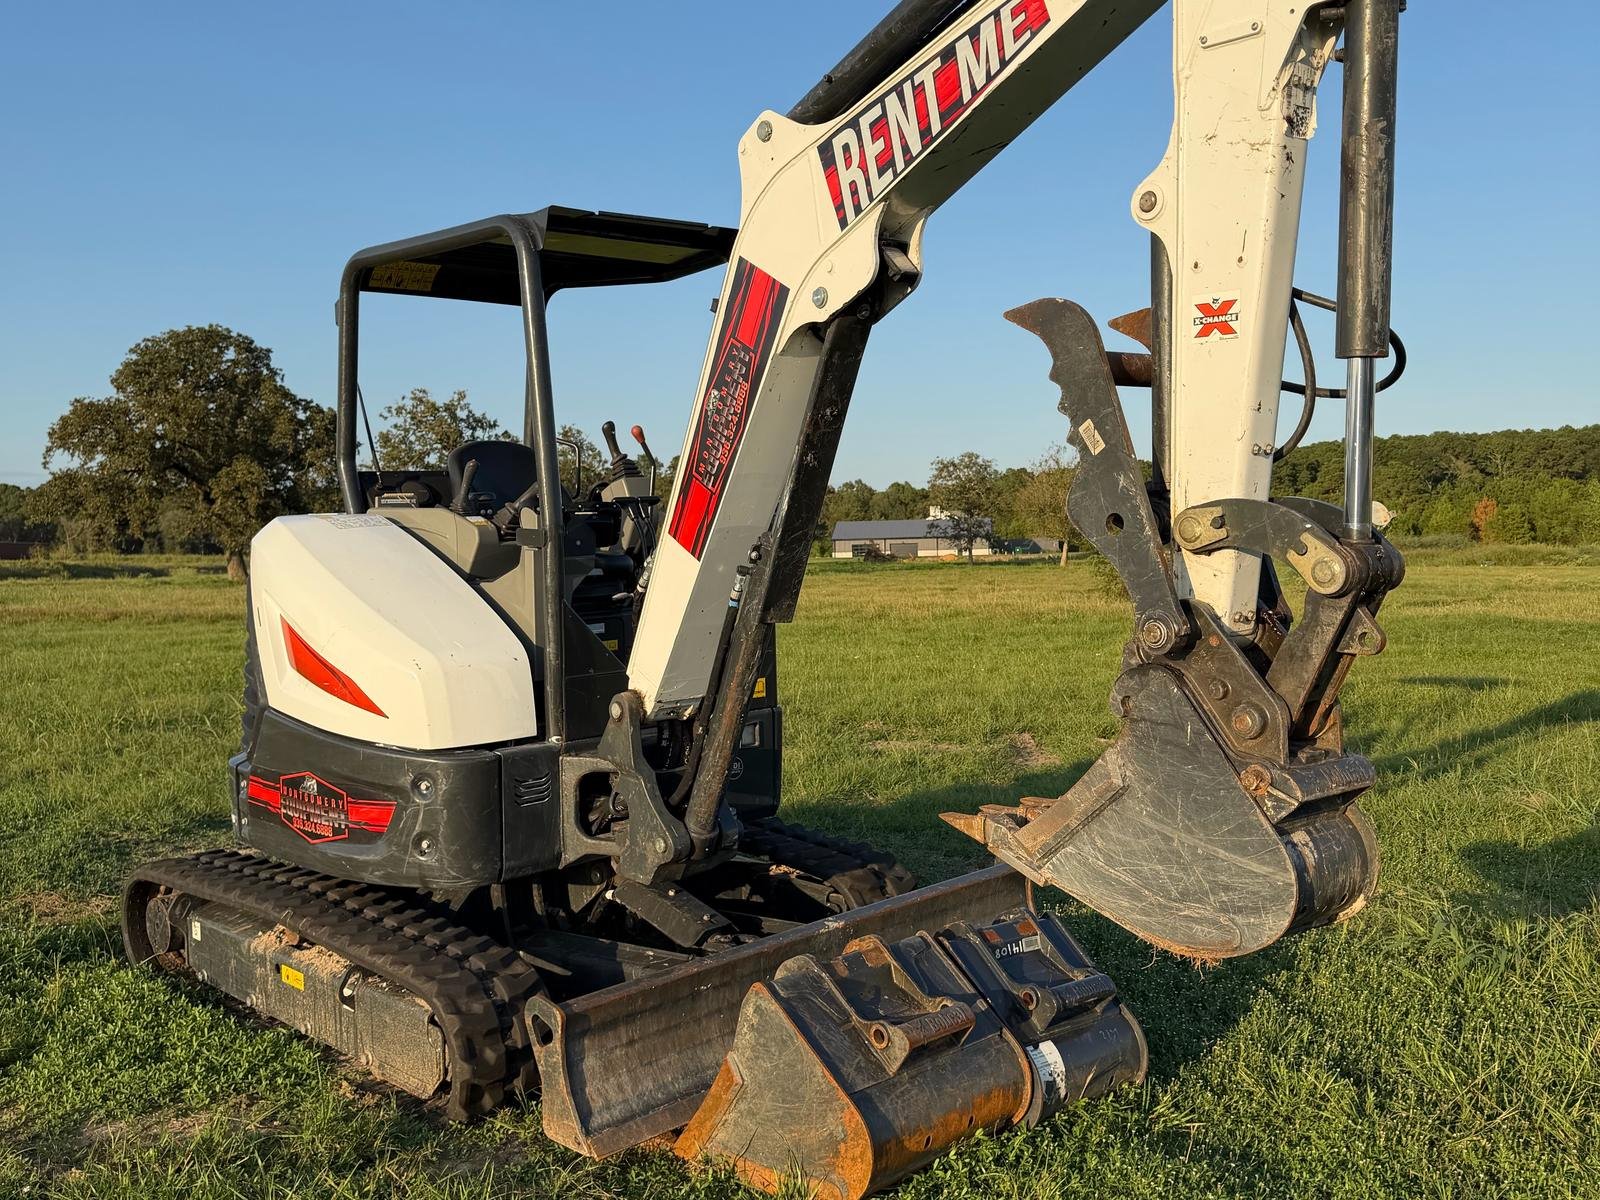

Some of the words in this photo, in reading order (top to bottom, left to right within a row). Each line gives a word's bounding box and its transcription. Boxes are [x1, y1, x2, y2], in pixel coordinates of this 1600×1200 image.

[832, 57, 942, 224] RENT
[955, 0, 1031, 104] ME
[1194, 313, 1237, 325] X-CHANGE
[698, 348, 739, 473] MONTGOMERY
[701, 346, 750, 489] EQUIPMENT
[281, 796, 348, 829] EQUIPMENT
[283, 786, 344, 809] MONTGOMERY
